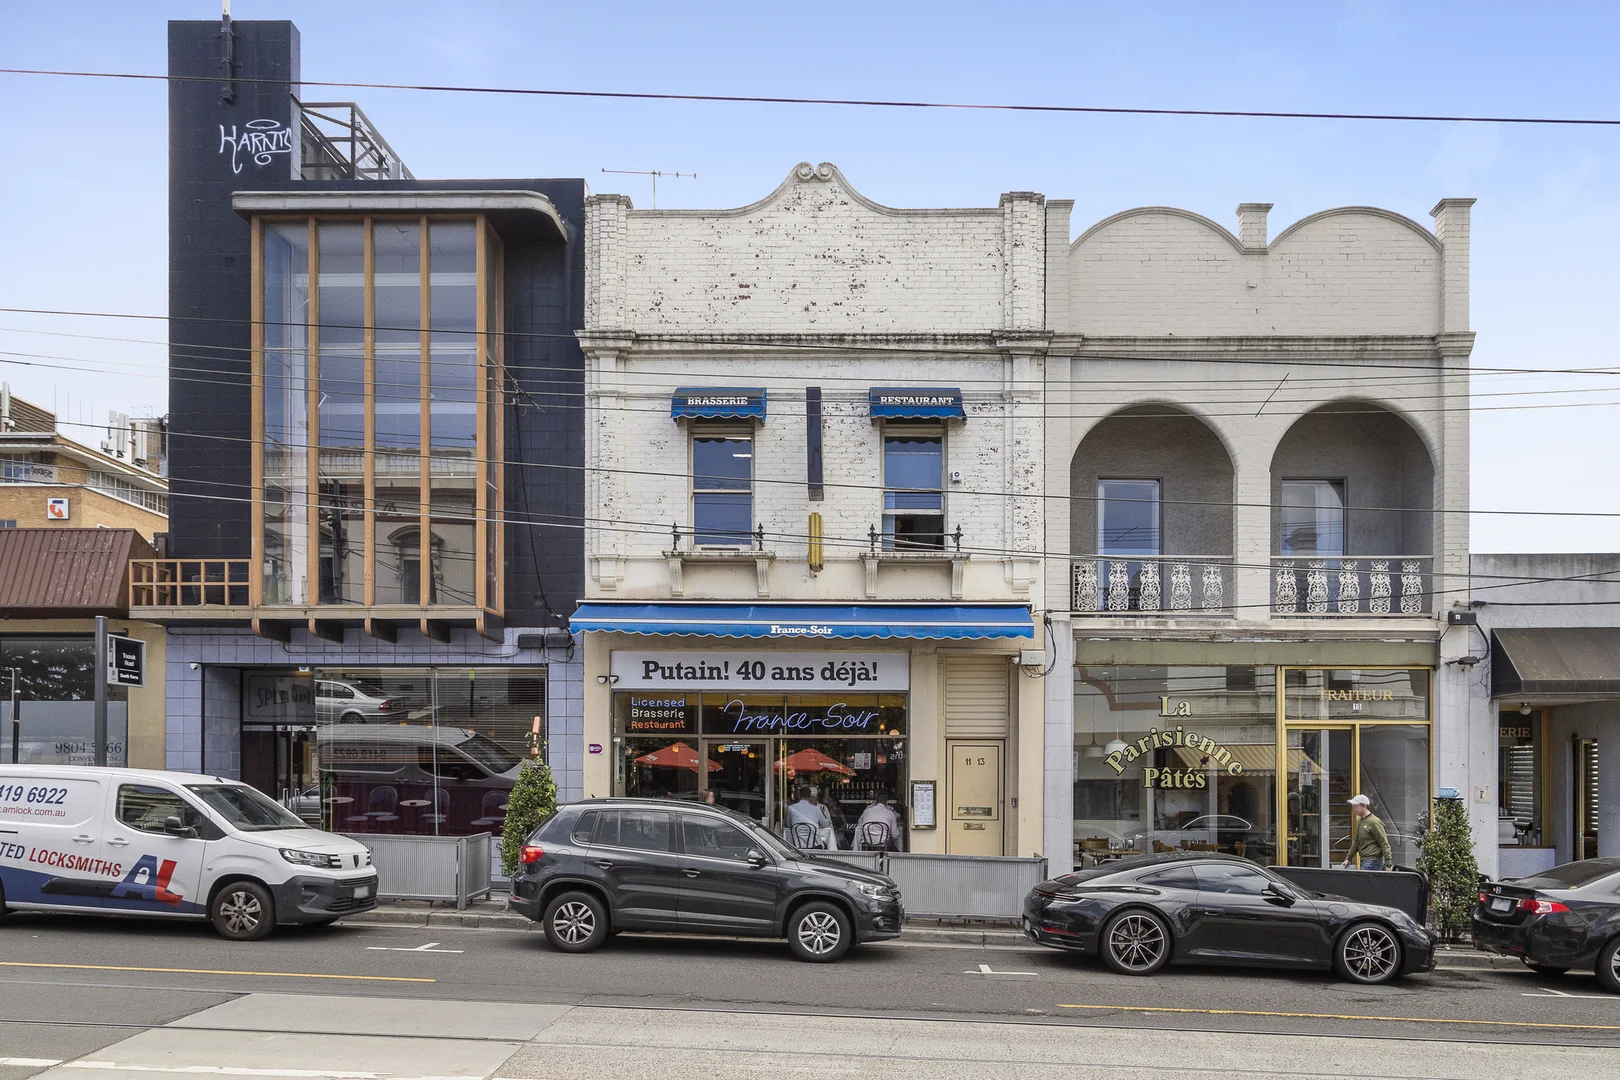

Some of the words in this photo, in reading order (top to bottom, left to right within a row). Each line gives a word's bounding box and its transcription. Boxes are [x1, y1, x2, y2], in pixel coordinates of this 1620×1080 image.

[687, 397, 748, 405] BRASSERIE
[880, 396, 954, 406] RESTAURANT
[770, 625, 833, 635] France-Soir
[642, 660, 729, 681] Putain!
[736, 660, 766, 681] 40
[771, 666, 815, 681] ans
[820, 661, 878, 687] déjà!
[1319, 690, 1394, 701] TRAITEUR
[631, 697, 685, 707] Licensed
[1158, 695, 1193, 717] La
[631, 708, 685, 719] Brasserie
[723, 699, 879, 733] France-Soir
[631, 720, 685, 729] Restaurant
[1499, 727, 1530, 738] ERIE
[55, 742, 87, 754] 9804
[1103, 725, 1244, 776] Parisienne
[965, 757, 972, 766] 11
[977, 757, 986, 766] 13
[1142, 766, 1206, 789] Pâtés
[27, 786, 68, 805] 6922
[0, 806, 66, 817] .amlock.com.au
[29, 847, 122, 877] LOCKSMITHS
